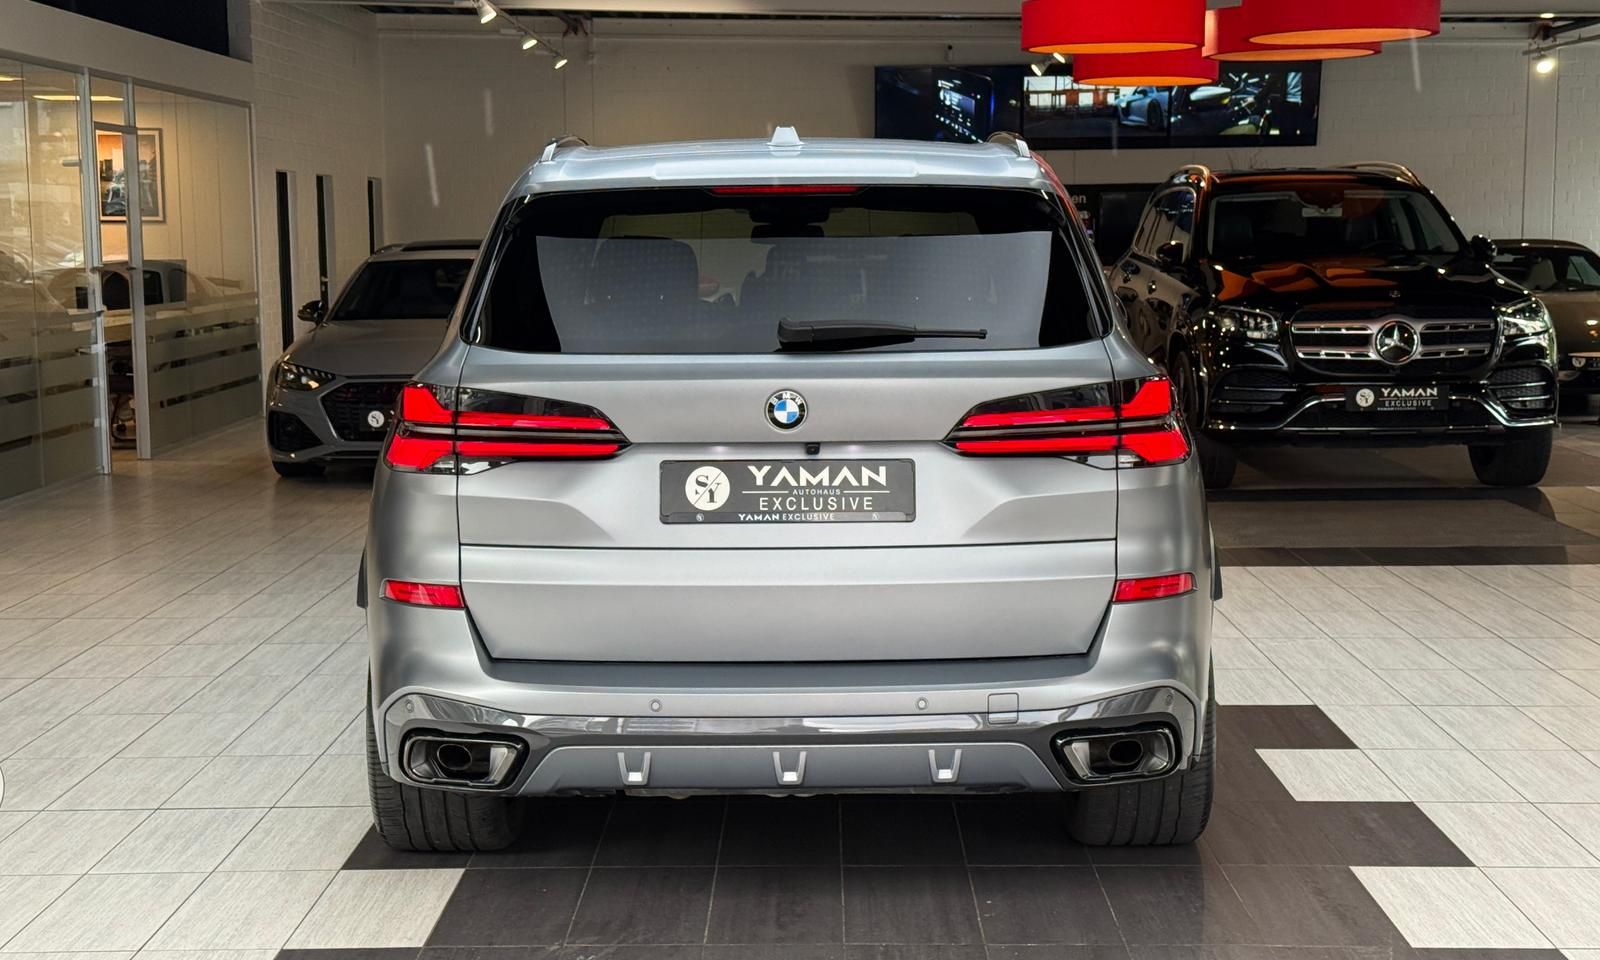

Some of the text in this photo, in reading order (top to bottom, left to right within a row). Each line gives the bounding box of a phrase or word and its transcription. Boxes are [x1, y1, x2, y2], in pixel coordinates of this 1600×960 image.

[1381, 387, 1438, 397] YAMAN
[1384, 399, 1432, 407] EXCLUSIVE
[747, 465, 887, 487] YAMAN
[759, 496, 873, 511] EXCLUSIVE
[738, 513, 835, 521] YAMAN EXCLUSIVE
